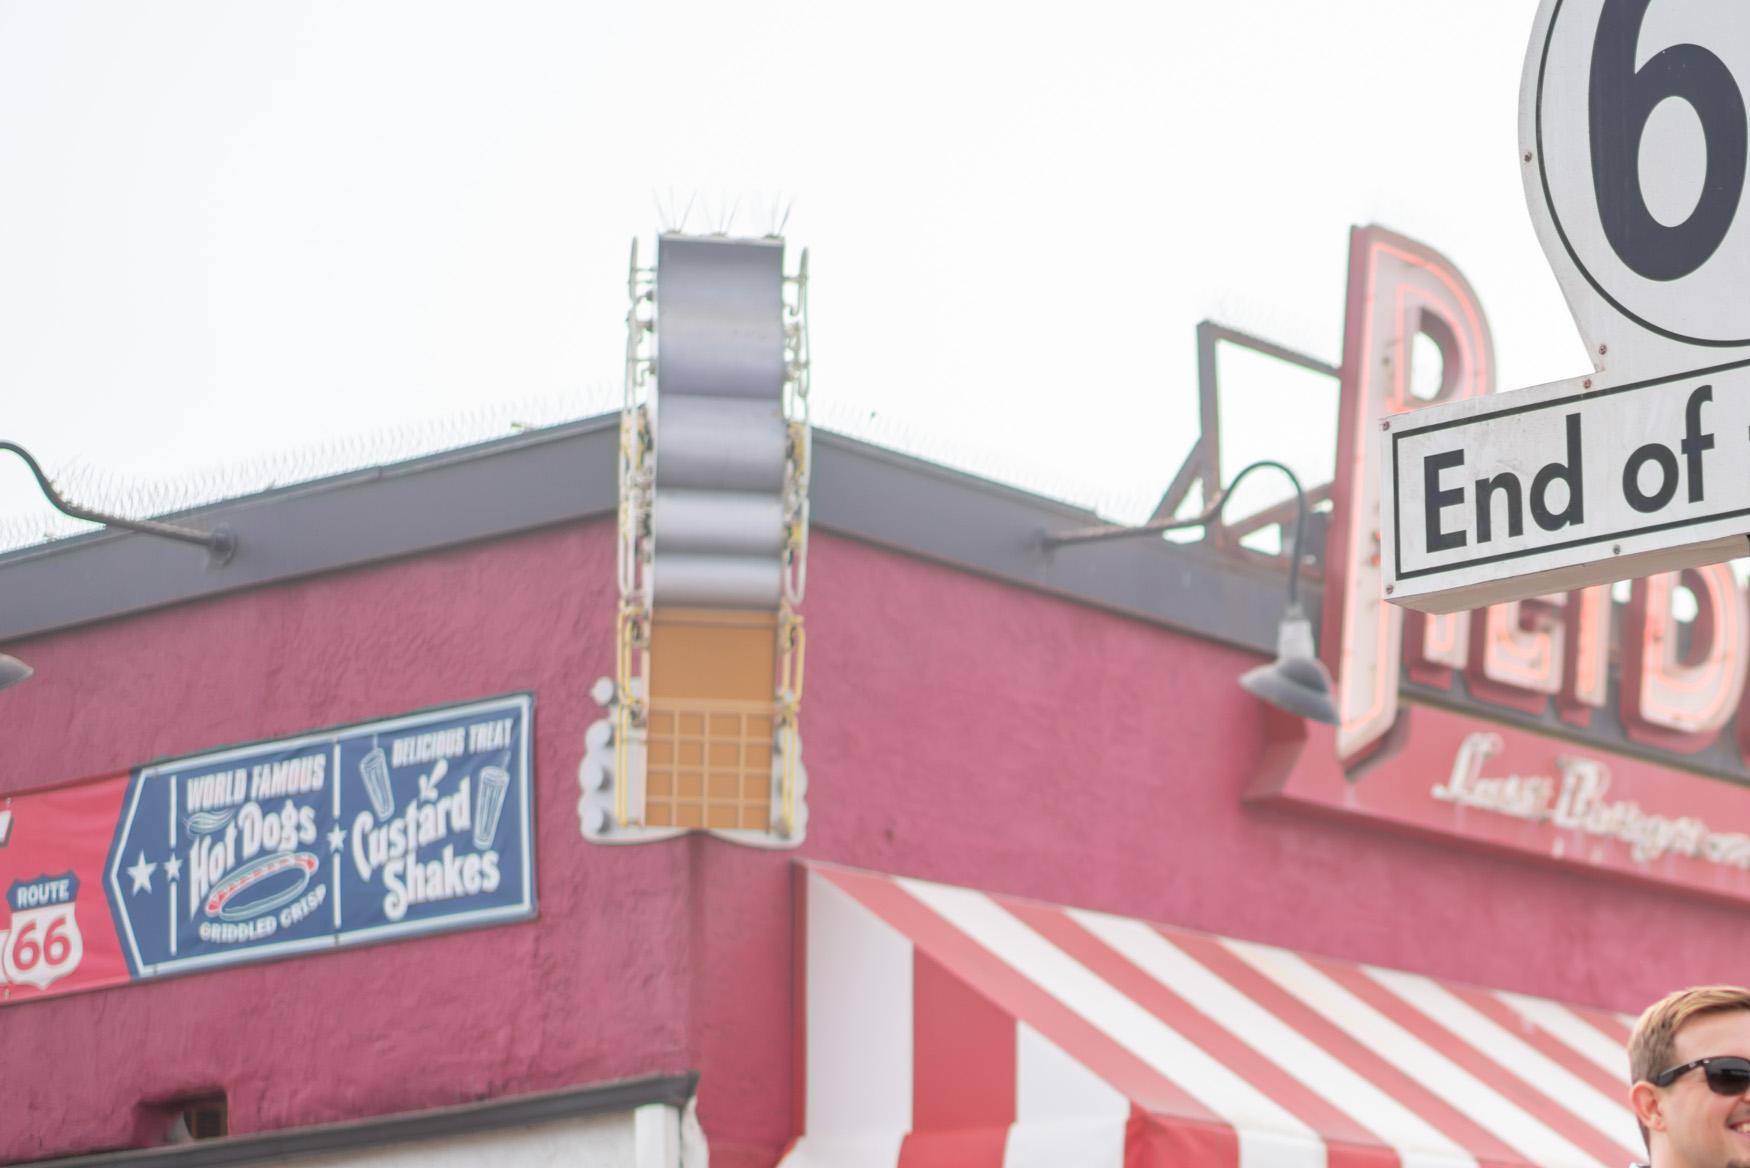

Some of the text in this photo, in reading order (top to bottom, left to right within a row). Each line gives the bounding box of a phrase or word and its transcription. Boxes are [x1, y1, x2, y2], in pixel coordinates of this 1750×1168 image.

[1424, 413, 1584, 554] End
[1622, 384, 1714, 514] of
[392, 718, 514, 768] DELICIOUS TREAT
[187, 753, 327, 813] WORLD FAMOUS
[352, 775, 471, 883] Custard
[189, 799, 318, 922] Hot Dogs
[383, 843, 500, 922] Shakes
[16, 878, 71, 910] ROUTE
[198, 883, 327, 944] GRIDDLED CRISP
[12, 914, 72, 972] 66
